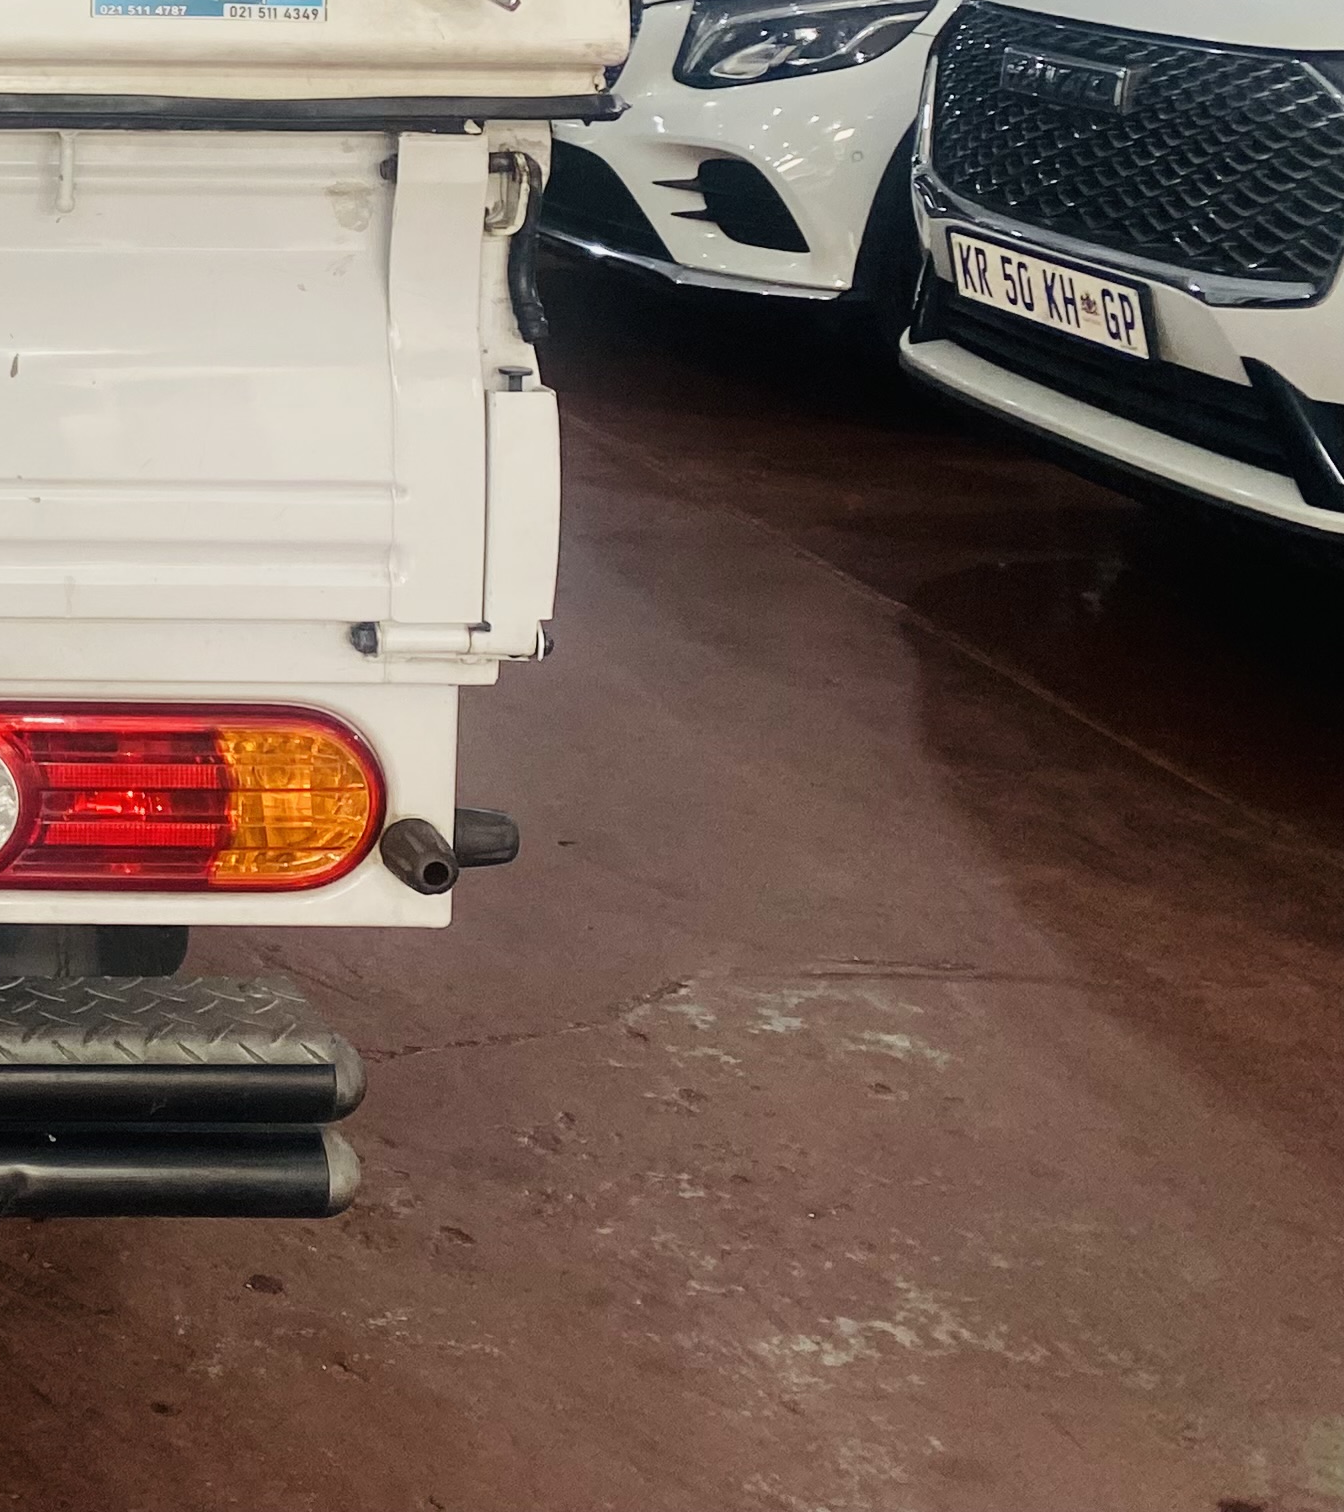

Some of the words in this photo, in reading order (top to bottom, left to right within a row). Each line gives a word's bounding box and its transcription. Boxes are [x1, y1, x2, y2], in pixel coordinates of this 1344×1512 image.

[99, 5, 123, 16] 021
[127, 5, 151, 16] 511
[155, 6, 188, 17] 4787
[229, 6, 252, 19] 021
[258, 6, 278, 20] 511
[283, 7, 319, 21] 4349
[958, 241, 994, 299] KR
[999, 255, 1035, 312] 50
[1042, 268, 1081, 329] KH
[1100, 287, 1136, 346] GP
